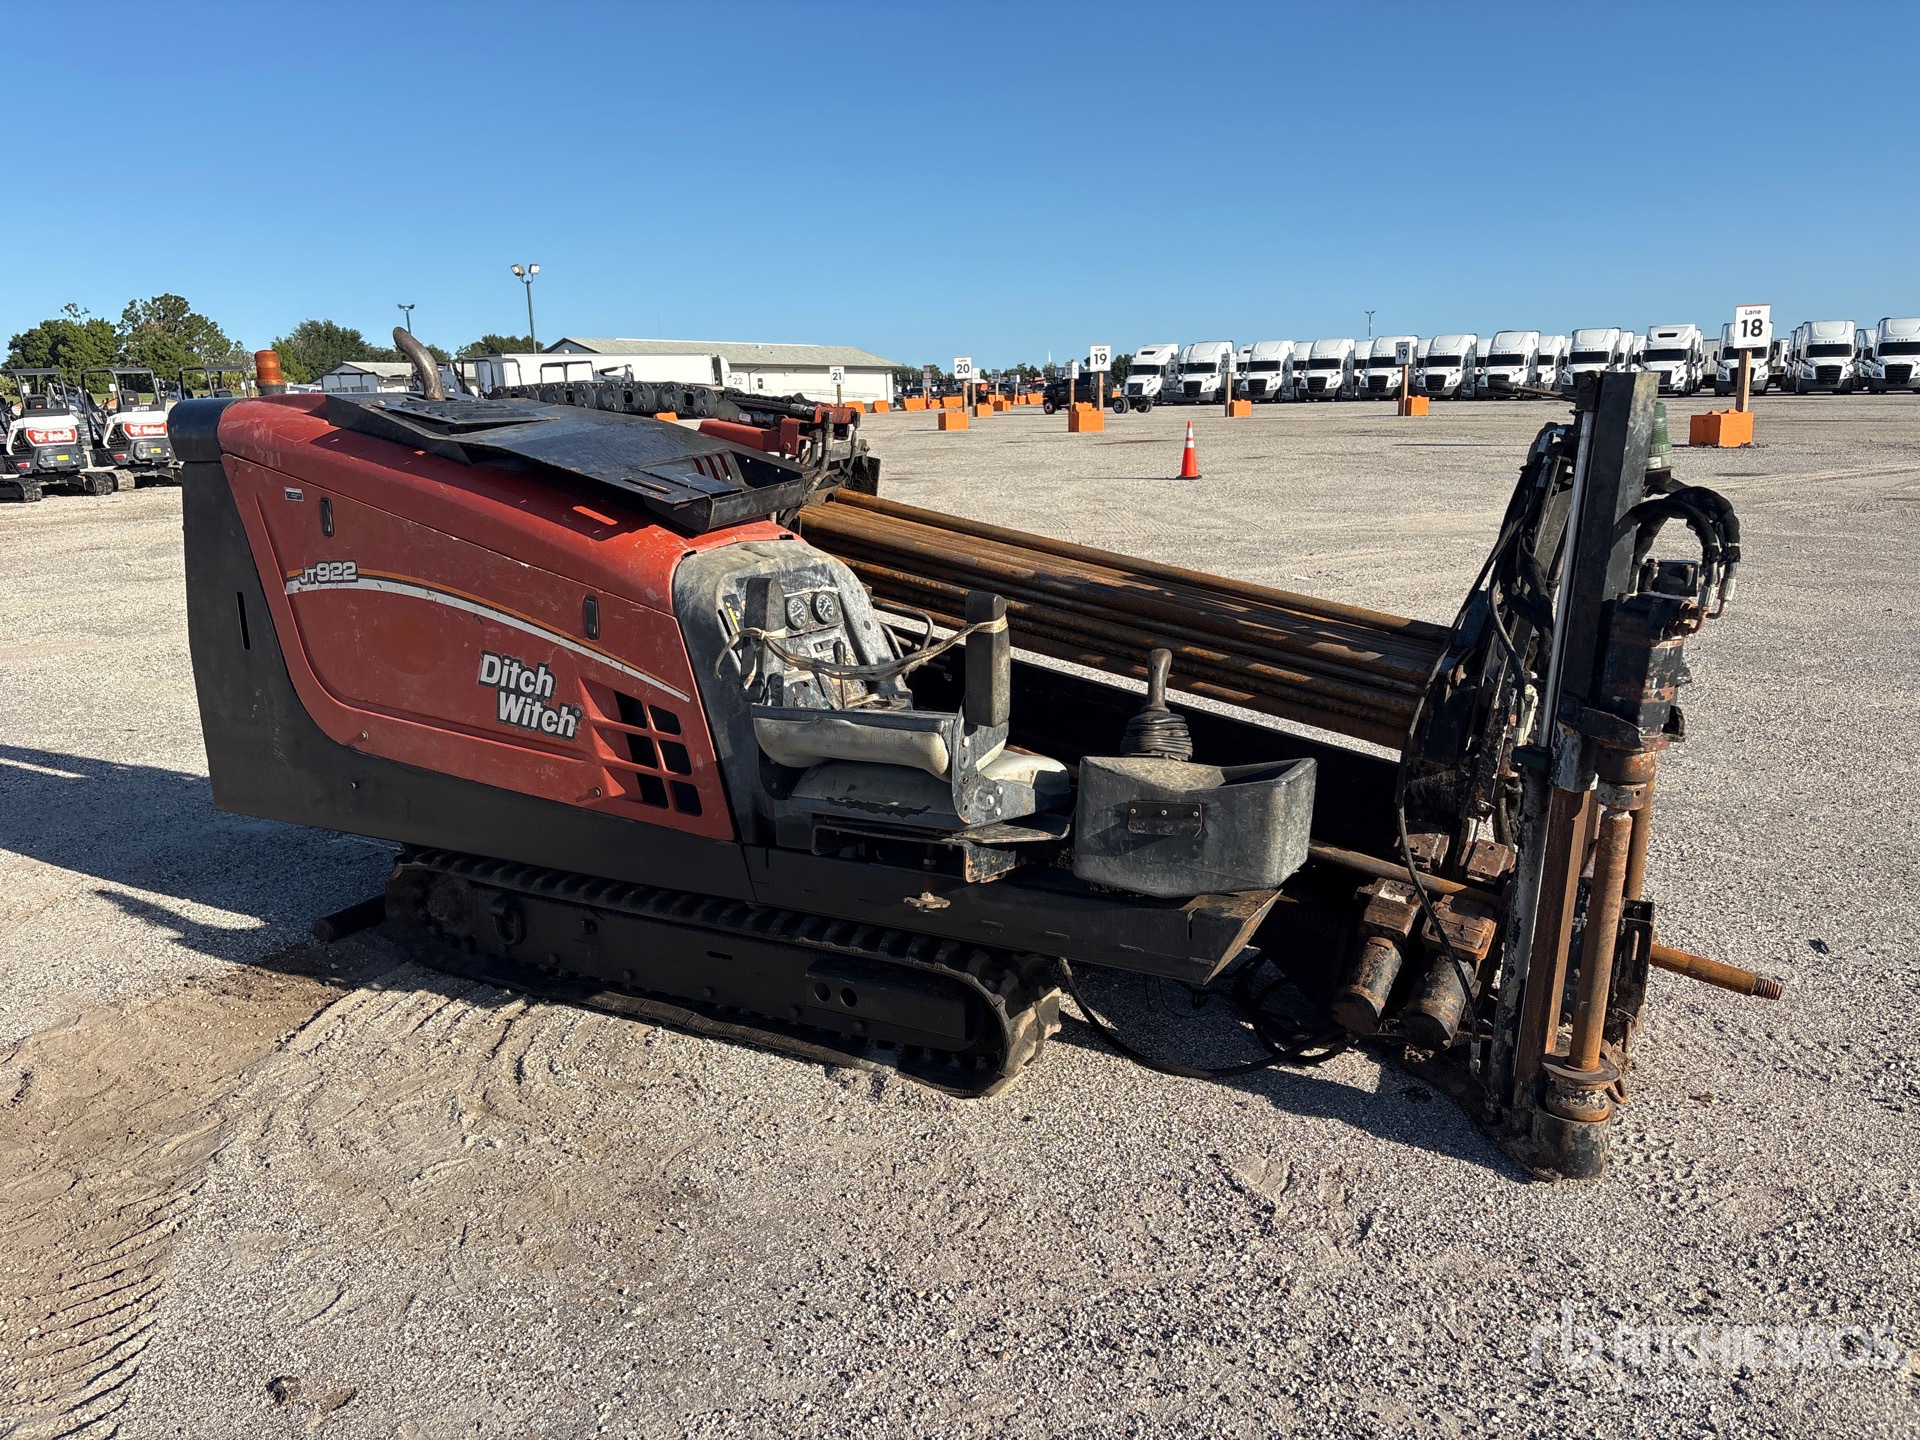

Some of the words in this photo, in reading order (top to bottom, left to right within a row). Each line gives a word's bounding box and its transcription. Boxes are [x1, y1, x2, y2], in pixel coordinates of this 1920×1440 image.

[1741, 318, 1763, 338] 18
[1094, 353, 1107, 365] 19
[1398, 349, 1408, 359] 19
[956, 363, 970, 374] 20
[832, 372, 842, 381] 21
[48, 429, 73, 441] Bobcat
[143, 425, 165, 435] Bobcat
[300, 561, 357, 583] JT922
[480, 654, 554, 697] Ditch
